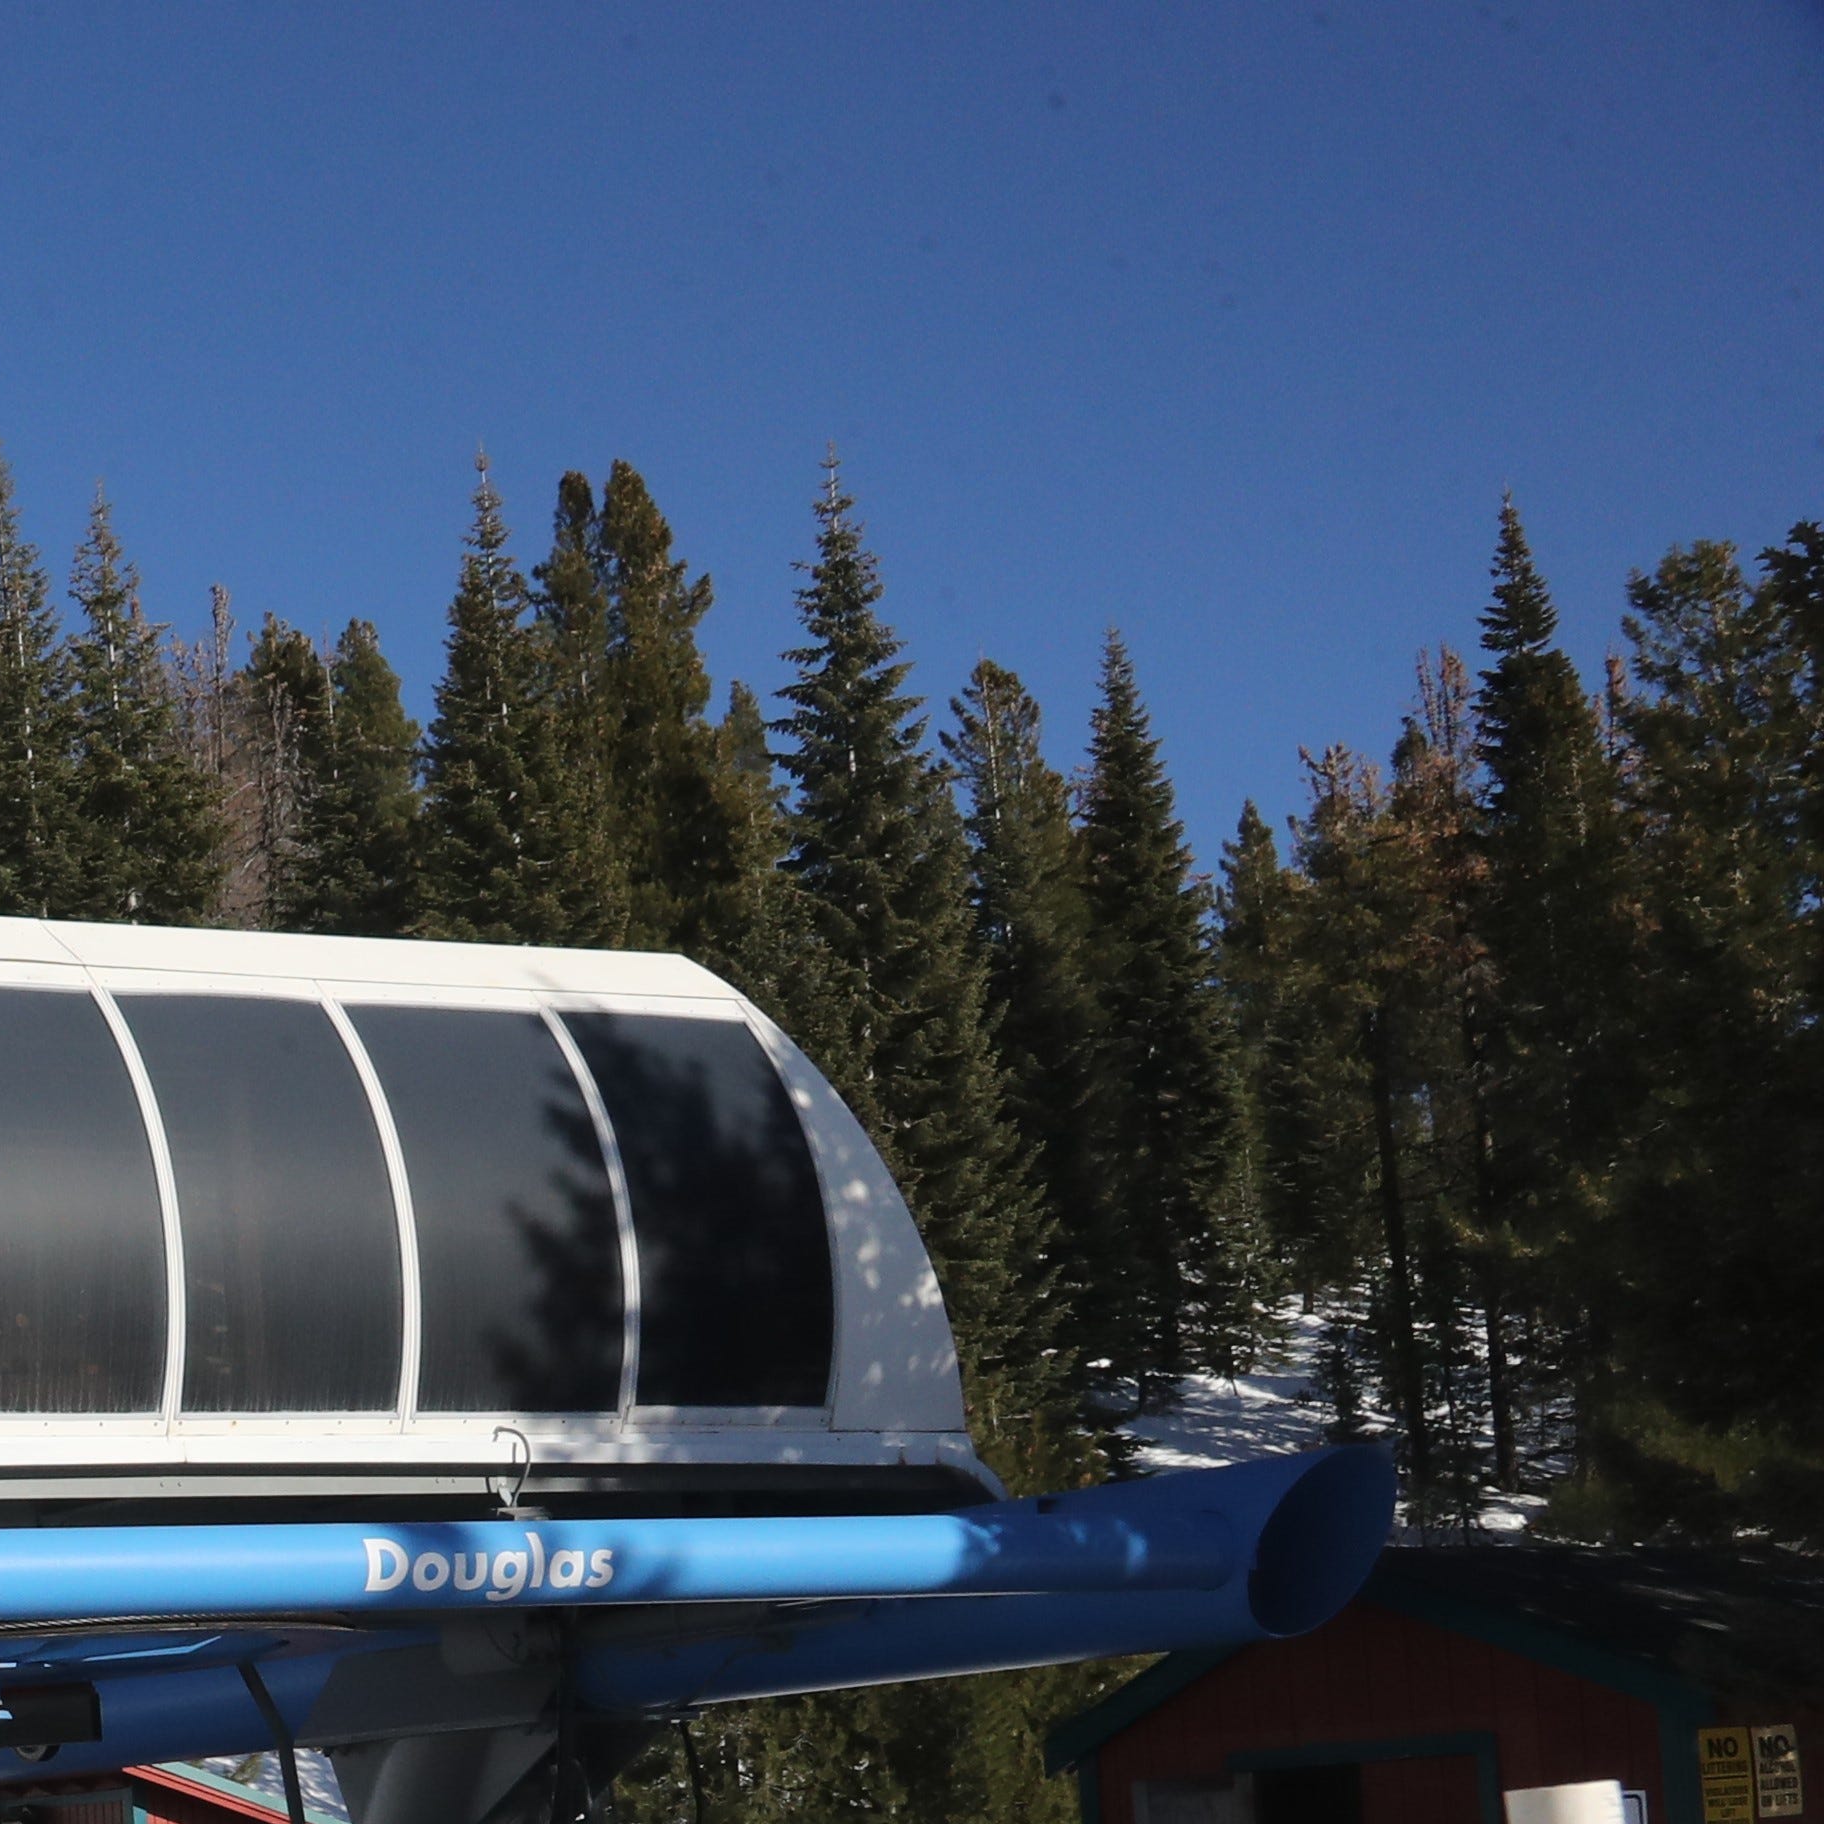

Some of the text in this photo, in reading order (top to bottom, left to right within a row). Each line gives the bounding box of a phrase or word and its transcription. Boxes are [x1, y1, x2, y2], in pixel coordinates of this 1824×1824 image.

[363, 1532, 615, 1602] Douglas
[1707, 1736, 1739, 1758] NO
[1758, 1735, 1791, 1757] NO
